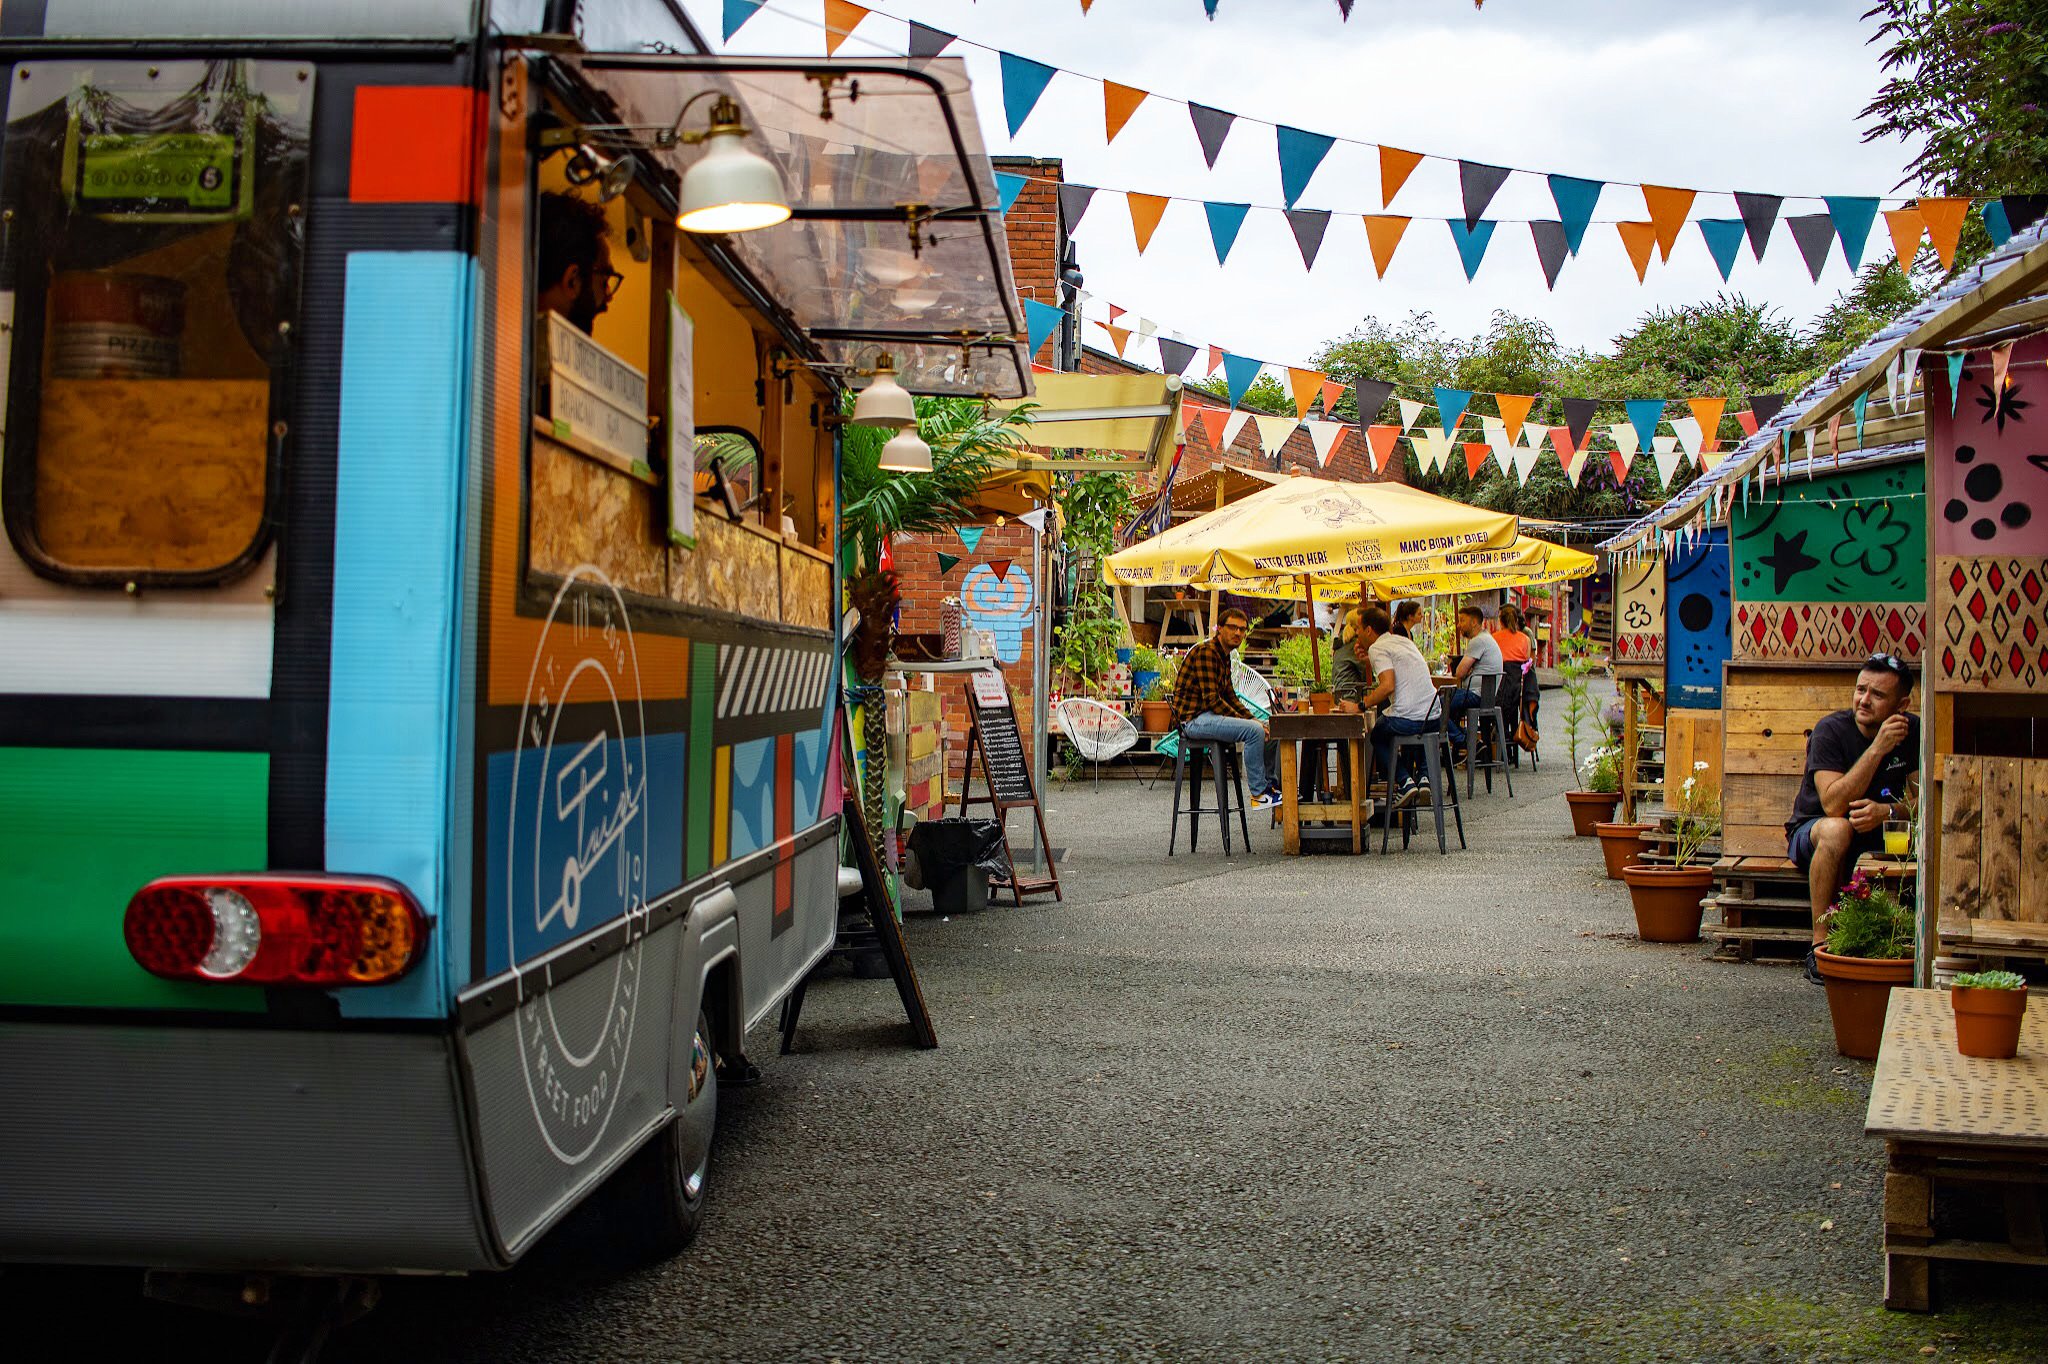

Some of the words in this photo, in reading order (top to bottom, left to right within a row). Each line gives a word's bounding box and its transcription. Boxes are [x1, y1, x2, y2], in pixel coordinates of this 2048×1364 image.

[1346, 543, 1382, 557] UNION
[1400, 540, 1427, 553] MANC
[1429, 536, 1454, 550] BORN
[1284, 553, 1306, 567] BEER
[1306, 550, 1329, 565] HERE
[1348, 552, 1384, 564] LAGER
[1445, 554, 1468, 566] MANC
[1470, 553, 1492, 564] BORN
[1401, 562, 1431, 572] LAGER
[1528, 571, 1547, 581] MANC
[531, 655, 561, 748] EST.
[525, 993, 570, 1122] STREET
[573, 1070, 608, 1128] FOOD
